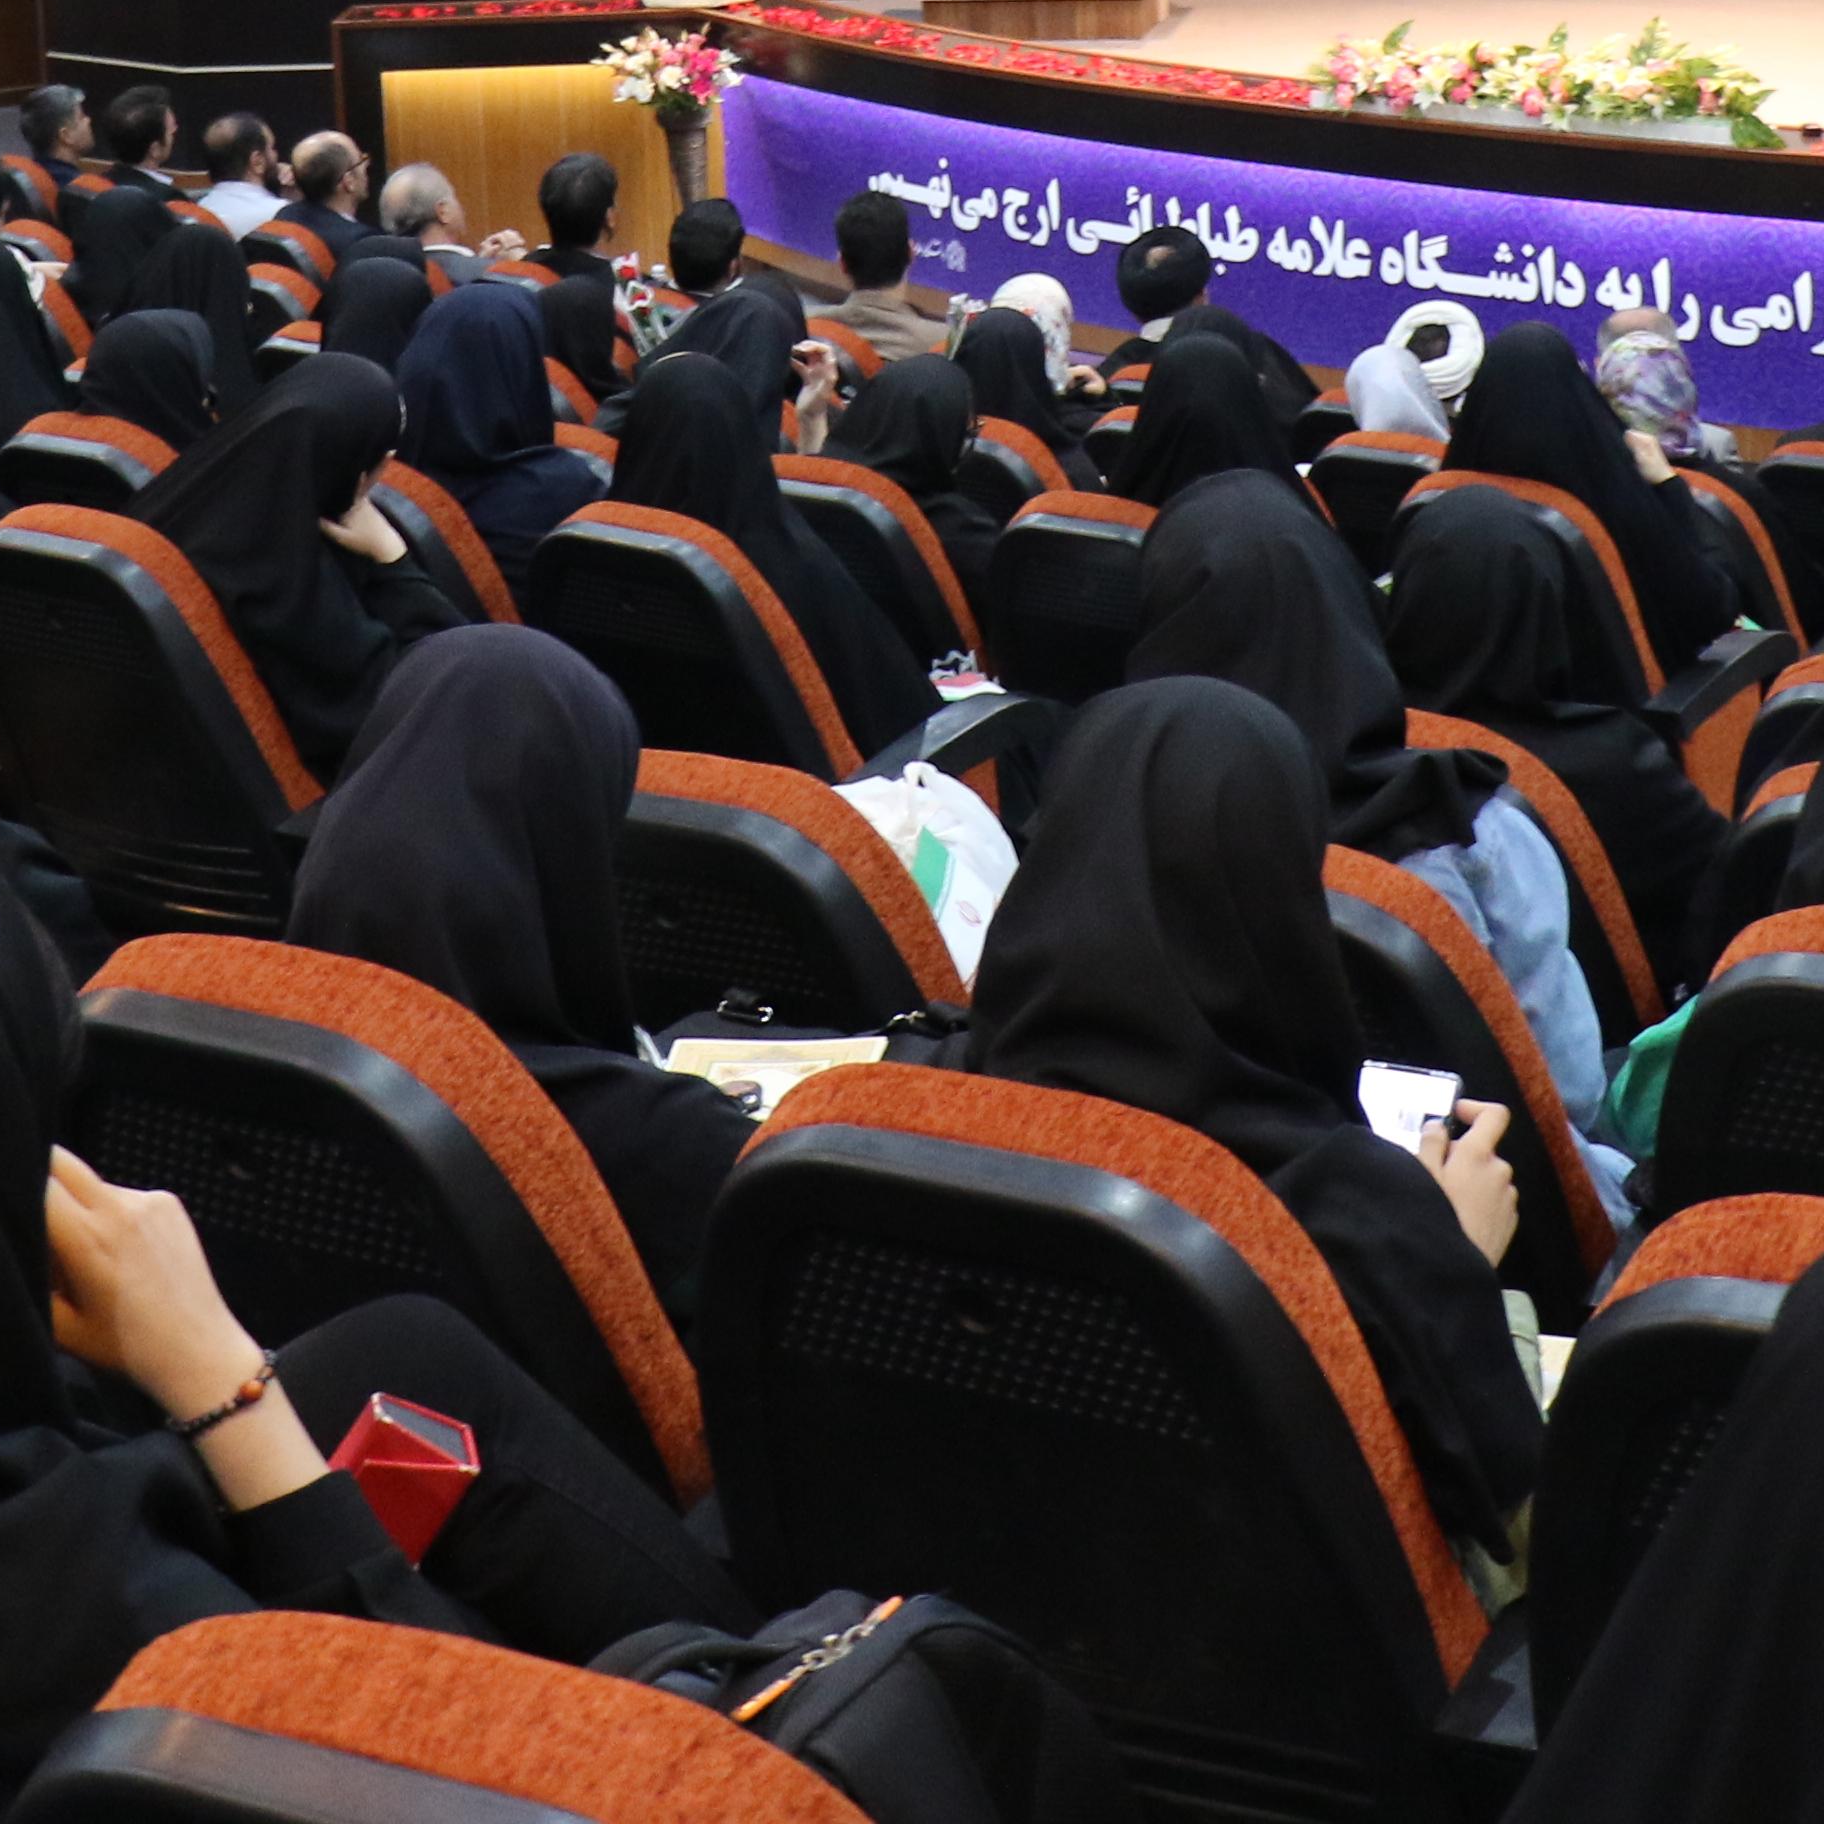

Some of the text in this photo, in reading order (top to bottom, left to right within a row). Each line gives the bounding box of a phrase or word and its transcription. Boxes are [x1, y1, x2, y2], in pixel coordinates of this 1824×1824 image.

[1002, 177, 1061, 247] ارج
[1265, 215, 1373, 279] علامه
[1379, 229, 1587, 308] دانشگاه
[1594, 266, 1644, 312] به
[1651, 257, 1701, 342] را
